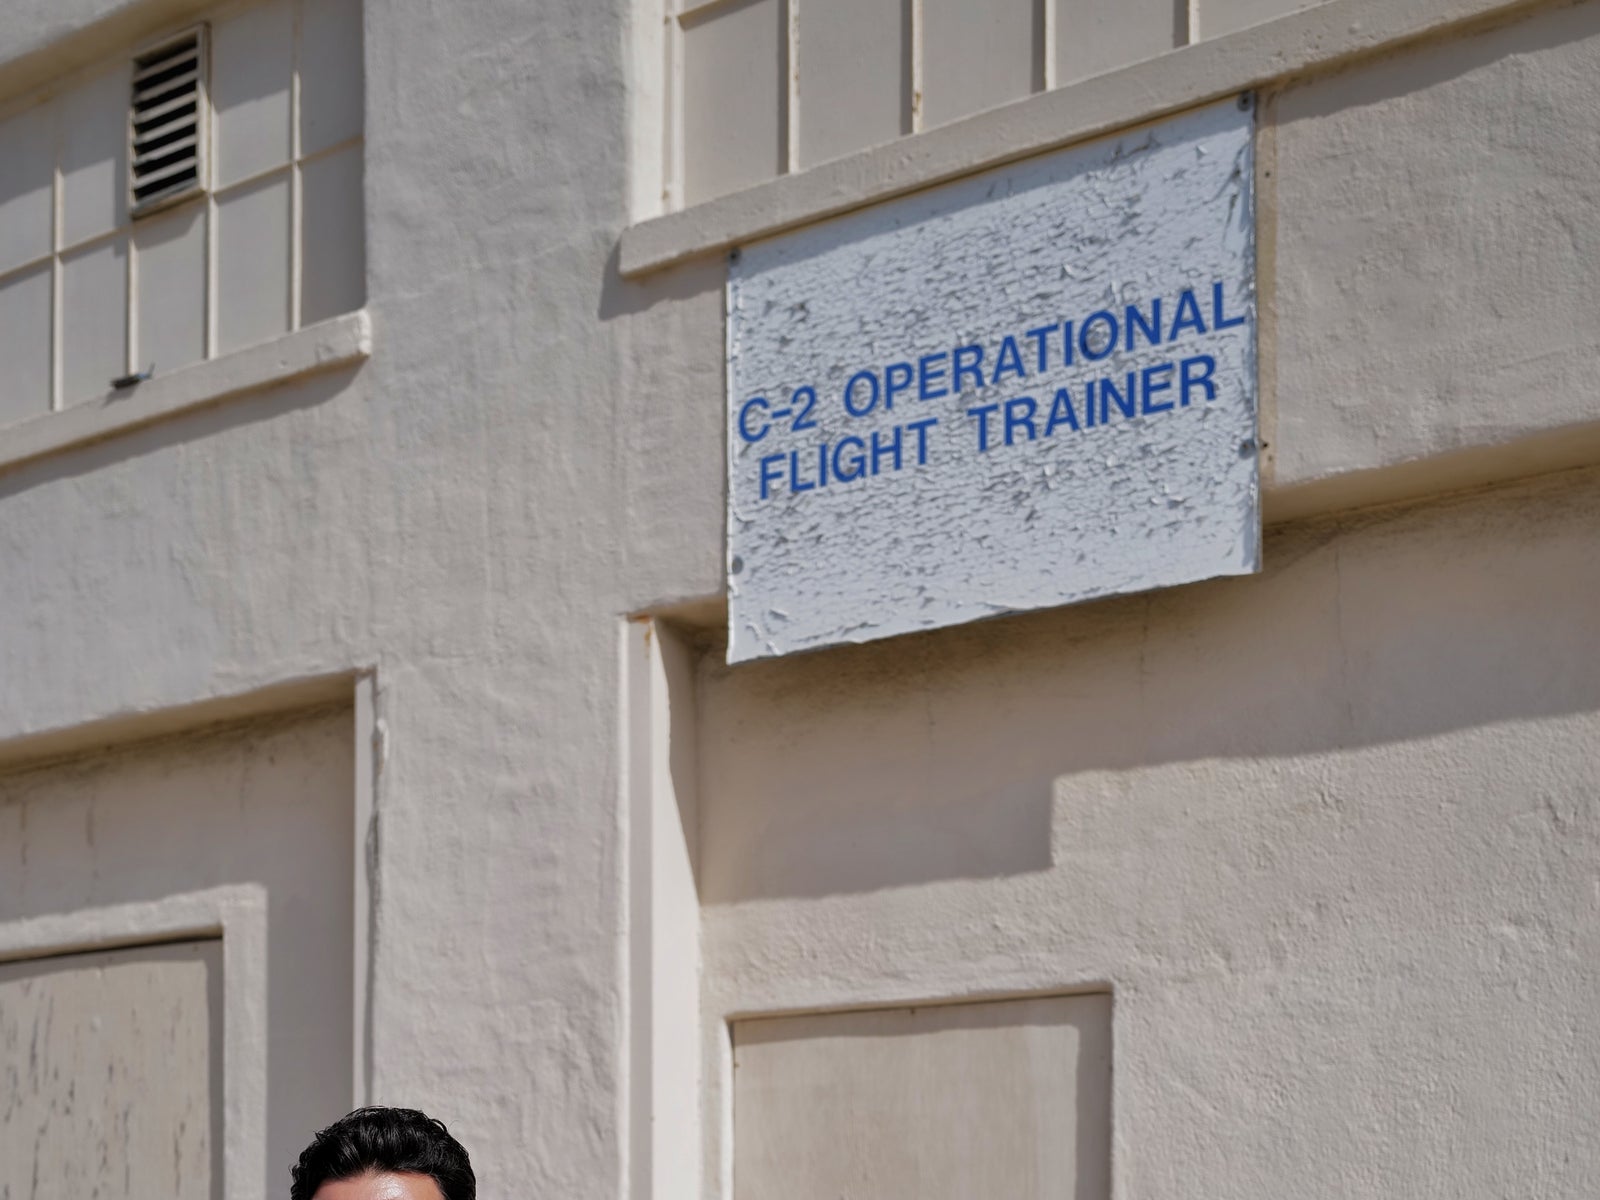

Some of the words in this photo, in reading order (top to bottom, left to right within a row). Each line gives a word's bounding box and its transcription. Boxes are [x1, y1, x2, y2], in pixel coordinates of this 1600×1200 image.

[737, 384, 817, 443] C-2
[843, 281, 1245, 418] OPERATIONAL
[758, 417, 939, 500] FLIGHT
[966, 353, 1217, 453] TRAINER
